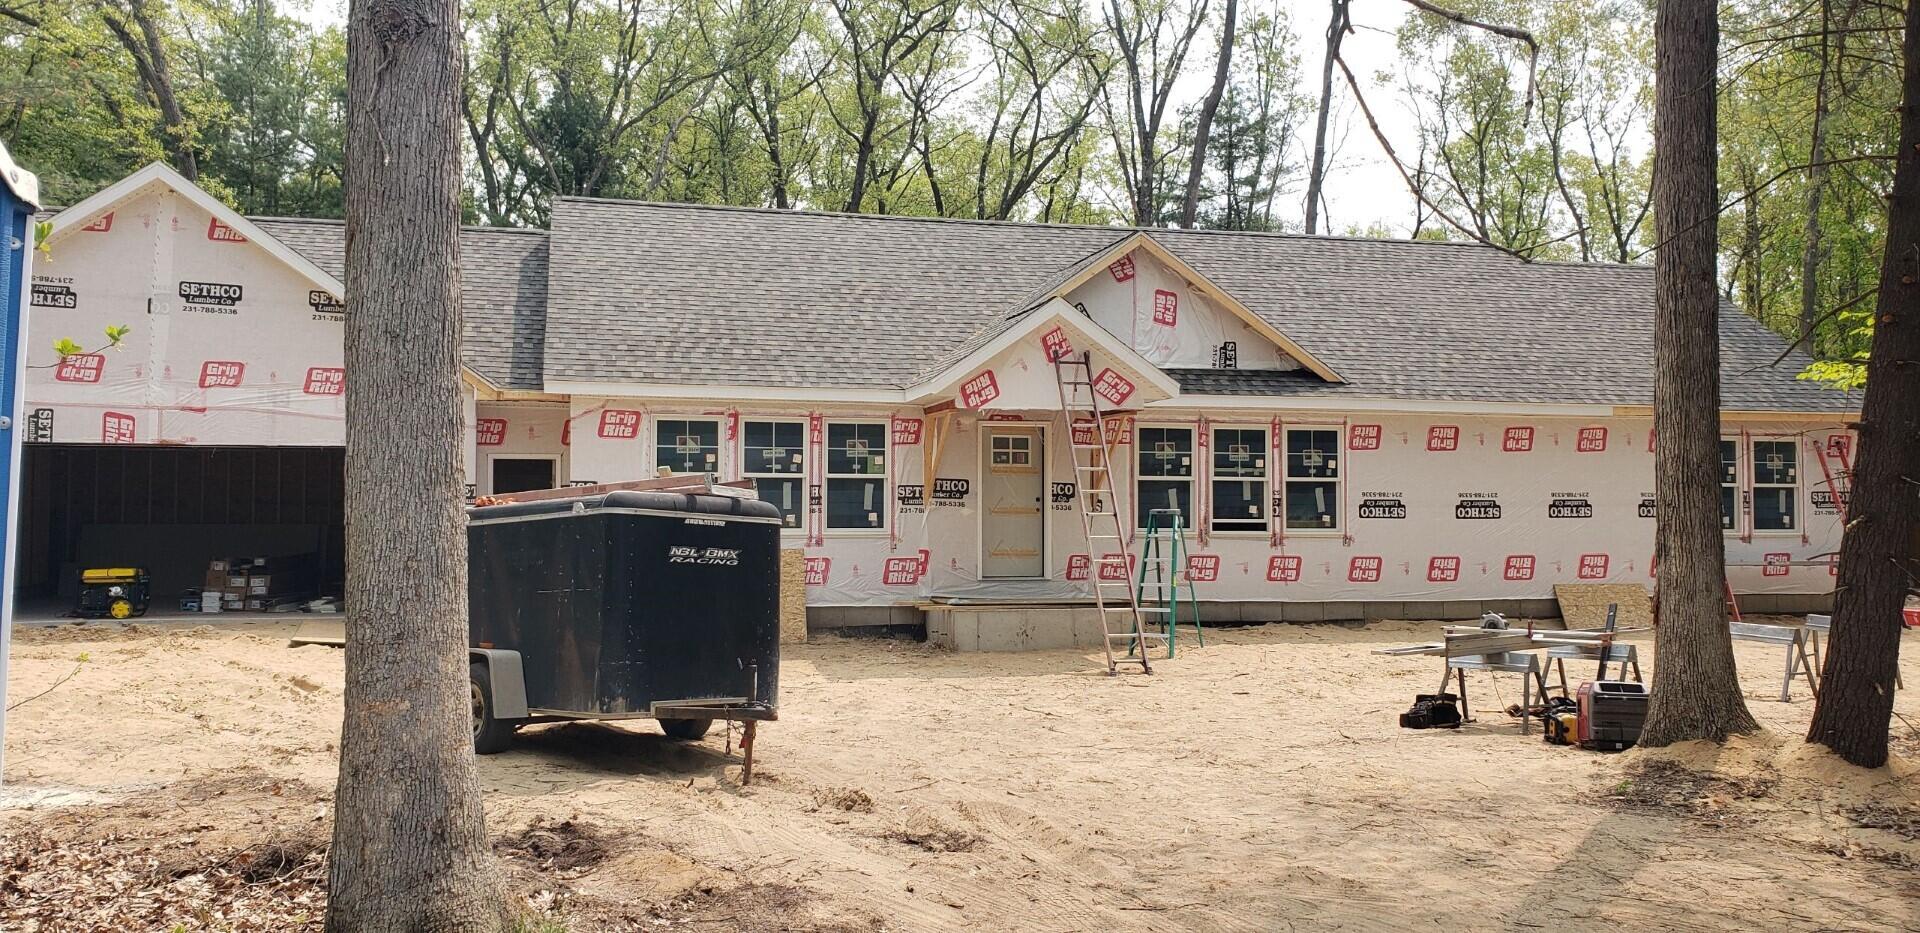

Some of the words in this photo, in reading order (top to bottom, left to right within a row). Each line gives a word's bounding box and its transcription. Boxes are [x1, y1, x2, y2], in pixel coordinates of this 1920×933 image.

[1112, 263, 1125, 278] ite
[1119, 254, 1134, 276] rip
[180, 283, 241, 298] SETHCO
[33, 294, 76, 307] SETH
[188, 296, 219, 304] Lumber
[182, 305, 238, 315] 231-788-5336
[319, 304, 344, 312] Lumbe
[1156, 294, 1165, 320] Rite
[1165, 295, 1176, 323] Grip
[1226, 343, 1235, 368] SET
[62, 366, 97, 381] Grip
[206, 363, 239, 376] Grip
[311, 369, 343, 383] Grip
[1102, 370, 1130, 394] Grip
[309, 381, 340, 394] Rite
[966, 373, 991, 394] Rite
[968, 385, 996, 407] Grip
[1095, 382, 1121, 402] Rite
[605, 412, 637, 426] Grip
[38, 410, 52, 443] SET
[120, 418, 133, 443] Gri
[603, 424, 633, 437] Rite
[1355, 426, 1377, 437] Rite
[1433, 427, 1455, 438] Rite
[1508, 428, 1529, 439] Rite
[1583, 429, 1603, 439] Rite
[1353, 437, 1376, 449] Grip
[1430, 437, 1454, 450] Grip
[1507, 438, 1529, 450] Grip
[1581, 439, 1603, 450] Grip
[935, 480, 967, 491] THCO
[898, 486, 924, 498] SET
[1360, 507, 1405, 517] SETHCO
[1457, 507, 1500, 518] SETHCO
[1550, 506, 1592, 517] SETHCO
[670, 557, 739, 566] RACING
[805, 559, 826, 571] rip
[889, 560, 917, 572] Grip
[1191, 557, 1216, 568] Rite
[1273, 558, 1297, 569] Rite
[1355, 558, 1378, 569] Rite
[1433, 558, 1456, 569] Rite
[1510, 557, 1531, 568] Rite
[1583, 556, 1605, 567] Rite
[1071, 567, 1088, 579] Rit
[1190, 567, 1215, 579] Grip
[1271, 568, 1296, 580] Grip
[1352, 568, 1377, 580] Grip
[1431, 568, 1455, 580] Grip
[1507, 567, 1531, 579] Grip
[1581, 566, 1604, 578] Grip
[1766, 566, 1786, 575] Rite
[806, 571, 823, 583] ite
[888, 571, 913, 583] Rite
